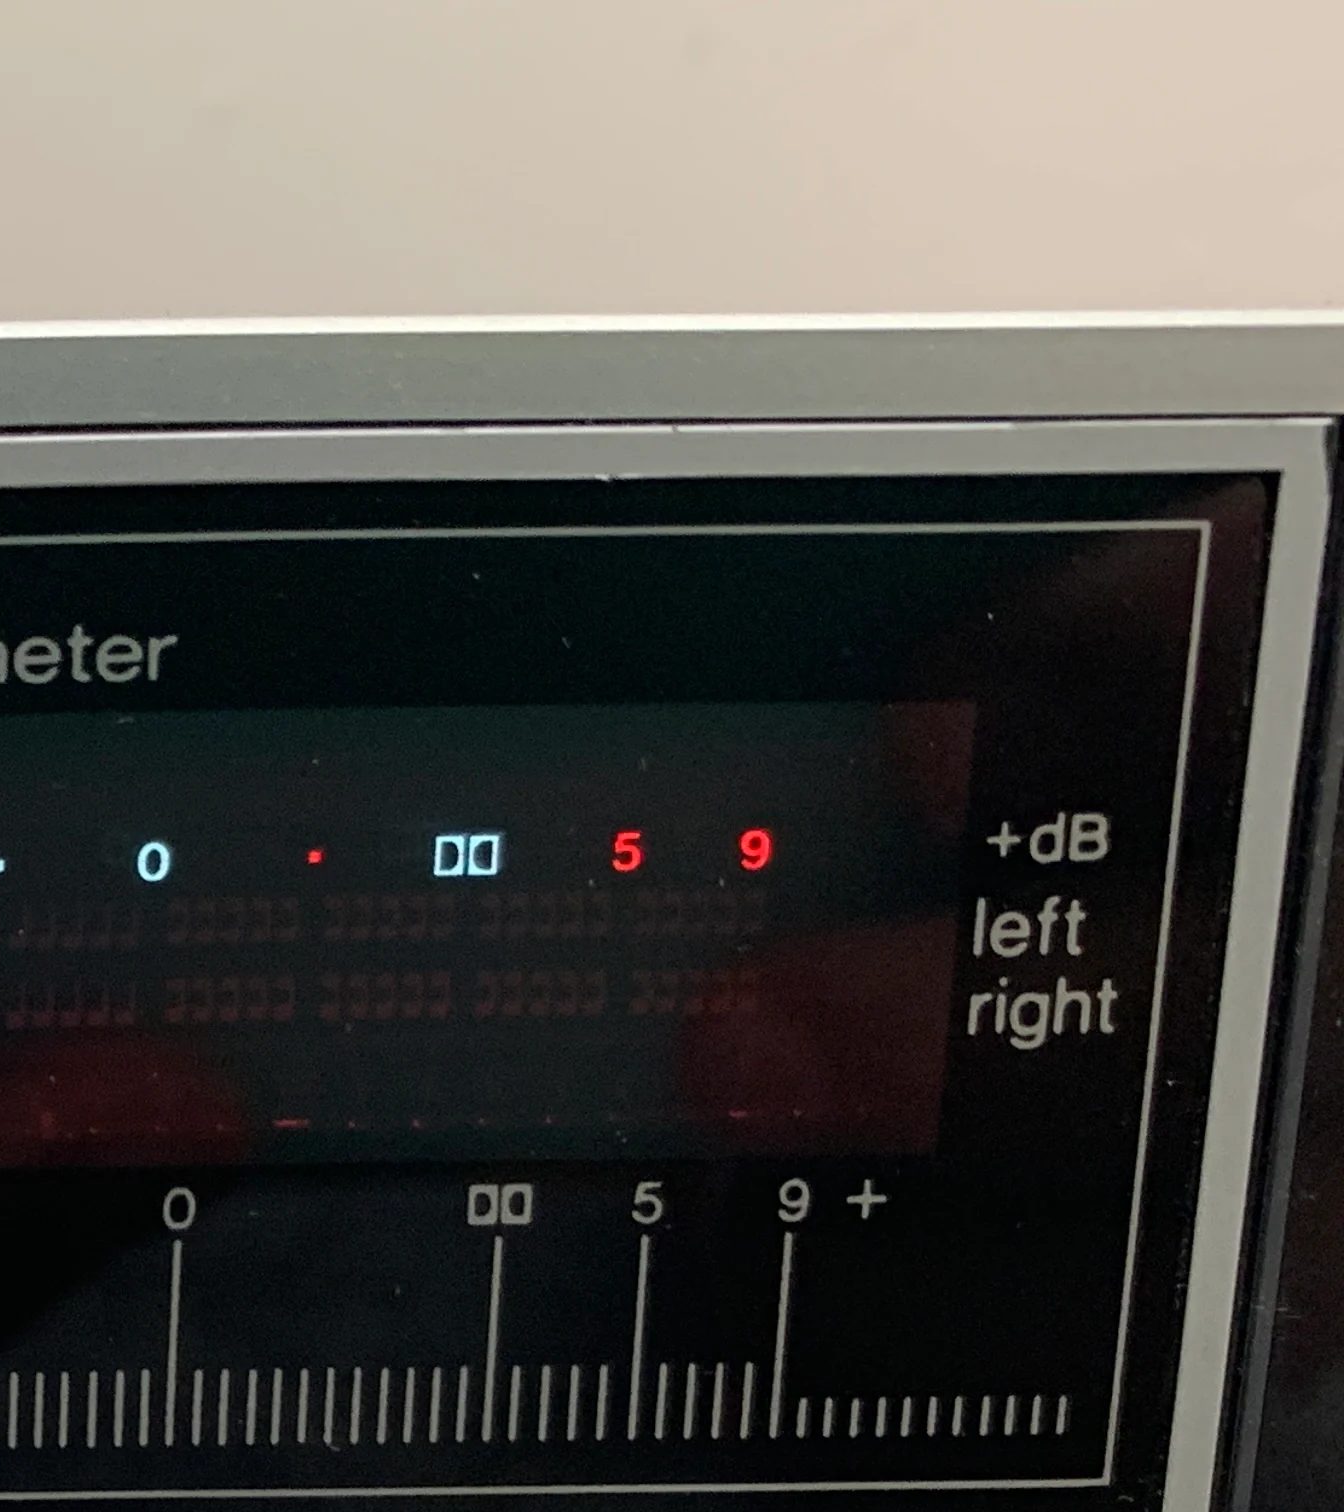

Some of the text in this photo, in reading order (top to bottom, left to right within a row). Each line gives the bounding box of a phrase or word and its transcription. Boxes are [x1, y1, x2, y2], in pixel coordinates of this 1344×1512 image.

[136, 840, 172, 883] 0
[611, 829, 644, 873] 5
[738, 827, 774, 872] 9
[985, 810, 1110, 865] +dB
[971, 894, 1088, 959] left
[966, 975, 1120, 1051] right
[161, 1186, 198, 1232] 0
[630, 1180, 665, 1226] 5
[777, 1176, 812, 1224] 9
